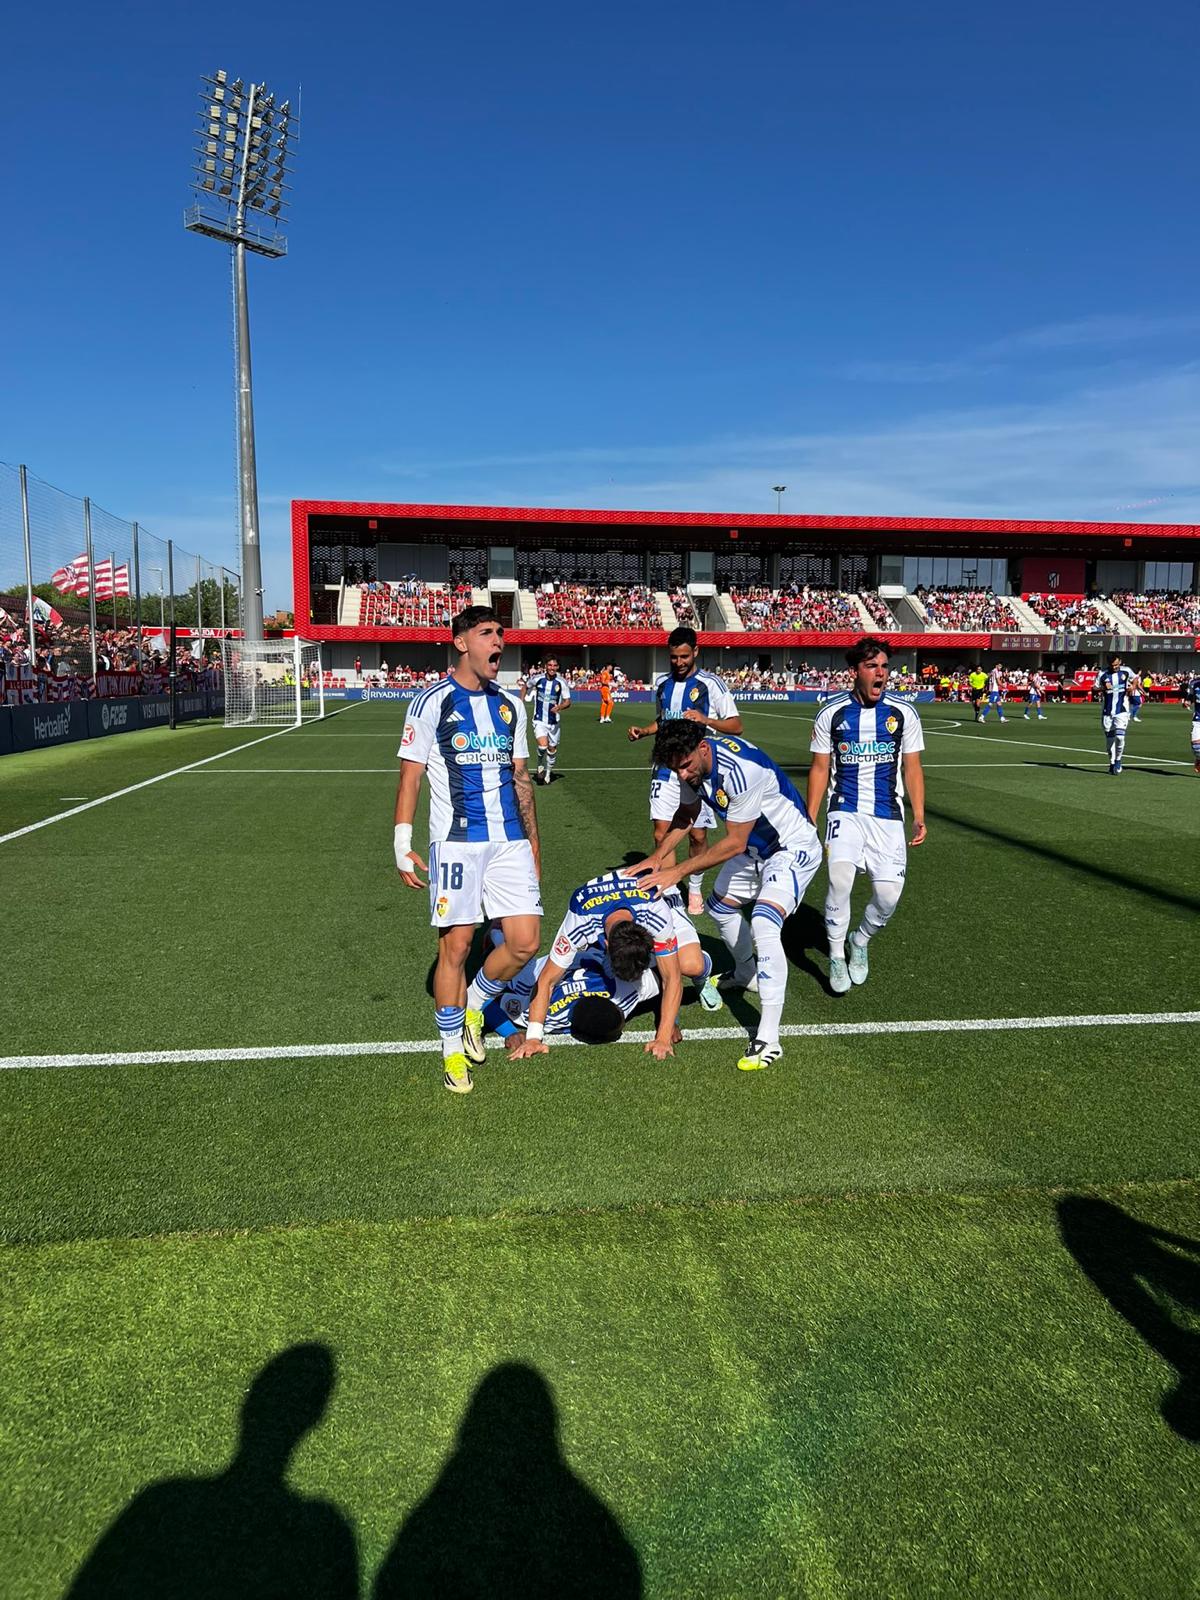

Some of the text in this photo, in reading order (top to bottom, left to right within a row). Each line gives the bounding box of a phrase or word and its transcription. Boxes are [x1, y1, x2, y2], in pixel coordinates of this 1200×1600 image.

[34, 713, 70, 740] Herbalife
[470, 731, 513, 750] tvitec
[851, 741, 896, 753] tvitec
[841, 754, 894, 763] CRICURSA
[828, 820, 841, 840] 12
[441, 862, 464, 890] 18
[587, 883, 615, 894] VALLE
[562, 980, 586, 995] KEITA
